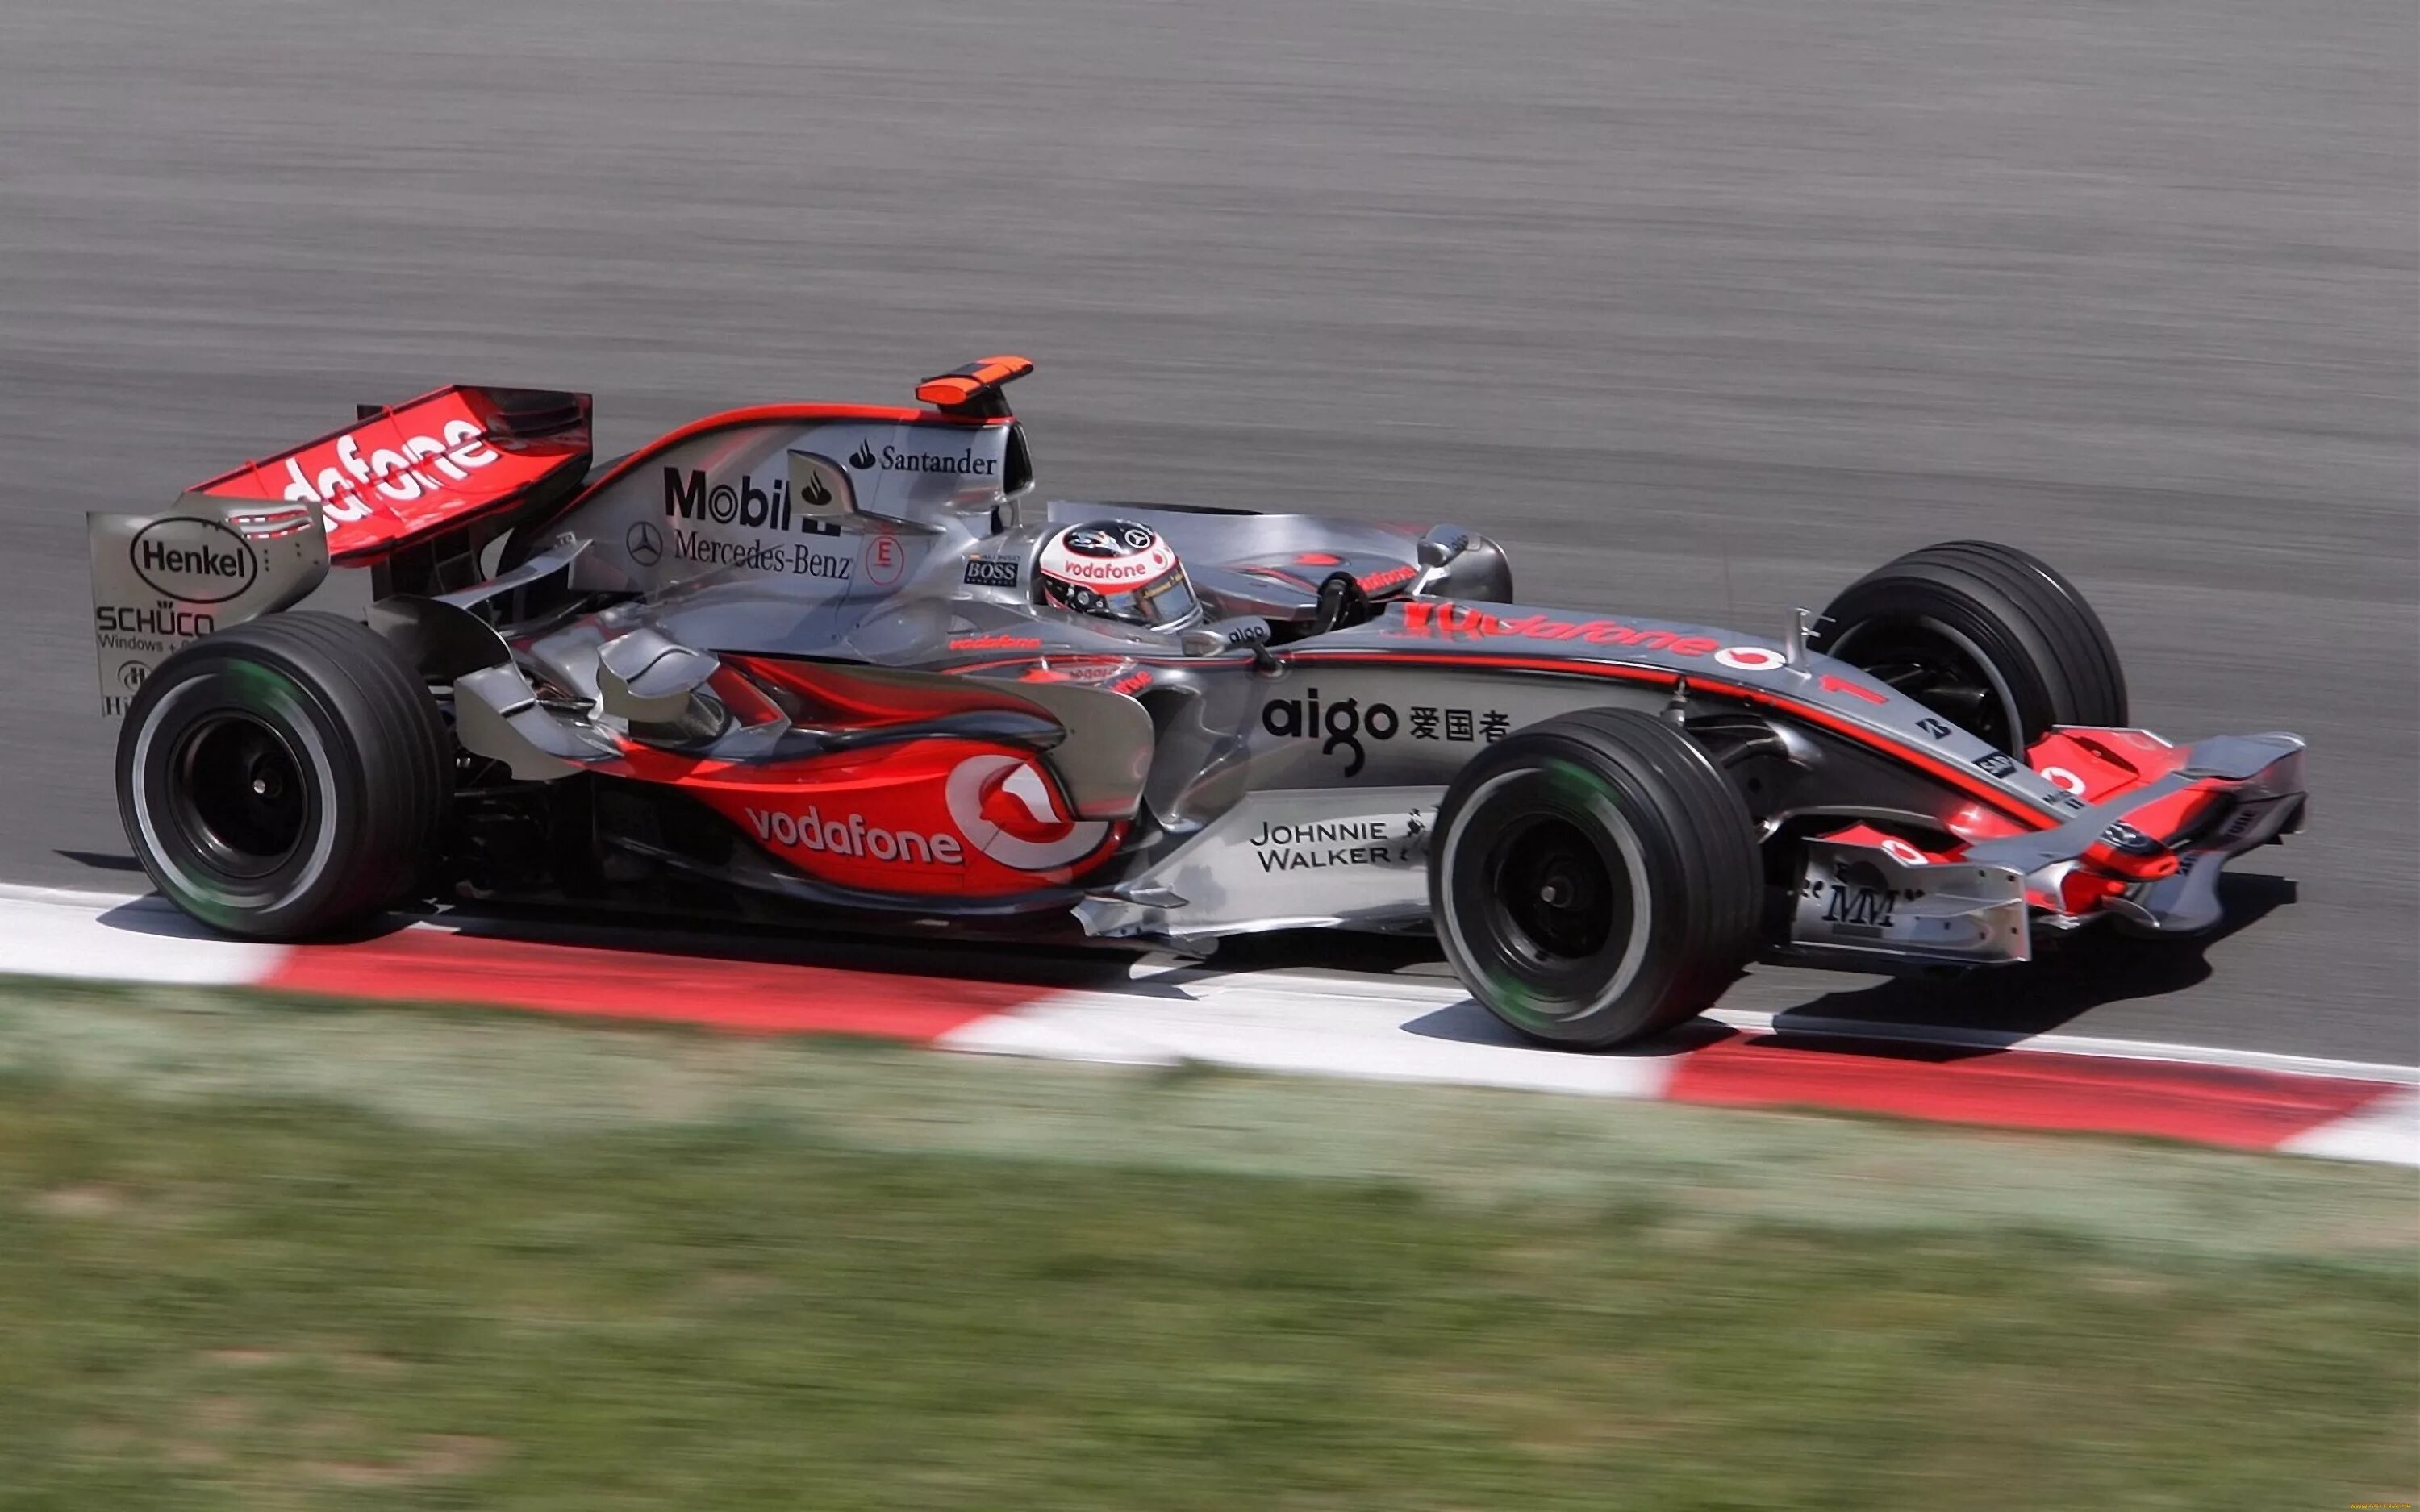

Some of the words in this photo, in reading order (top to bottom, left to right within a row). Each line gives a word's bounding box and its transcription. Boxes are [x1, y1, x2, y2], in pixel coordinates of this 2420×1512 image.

[881, 445, 997, 475] Santander
[283, 419, 496, 532] dafone
[663, 467, 791, 531] Mobil
[143, 540, 245, 578] Henkel
[674, 529, 853, 581] Mercedes-Benz
[878, 541, 891, 562] E
[968, 562, 1016, 580] BOSS
[1065, 559, 1146, 579] vodafone
[97, 600, 215, 638] SCHÜCO
[98, 634, 163, 652] Windows
[1262, 687, 1400, 778] aigo
[1409, 706, 1511, 743] 爱国者
[1979, 756, 2012, 774] SAP
[744, 806, 964, 864] vodafone
[1250, 821, 1388, 847] JOHNNIE
[1257, 847, 1392, 873] WALKER
